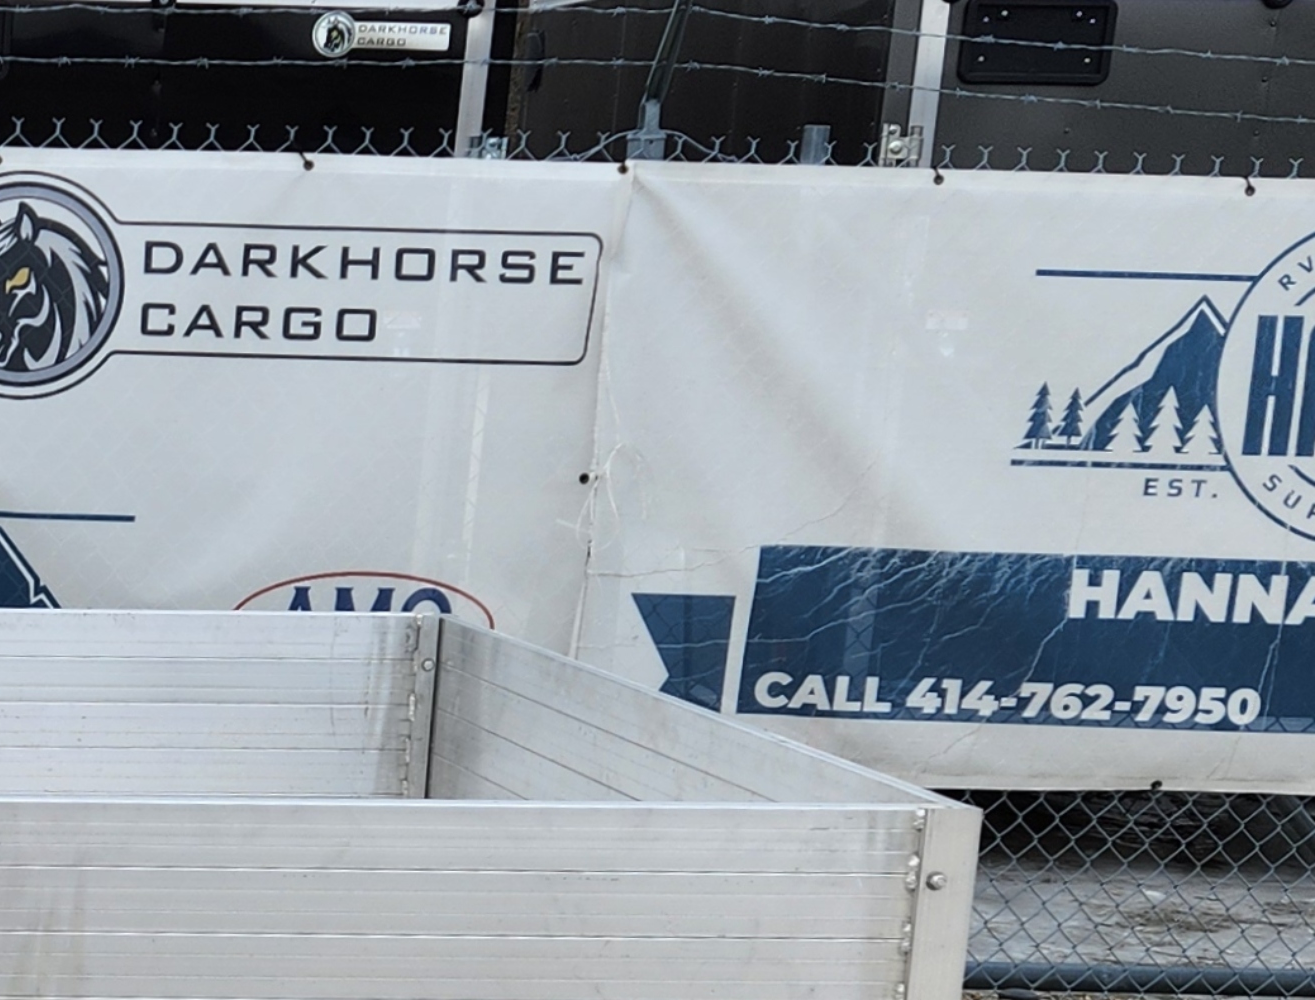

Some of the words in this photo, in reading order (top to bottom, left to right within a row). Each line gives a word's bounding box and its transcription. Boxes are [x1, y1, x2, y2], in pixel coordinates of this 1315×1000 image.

[357, 36, 407, 47] CARGO
[358, 23, 448, 36] DARKHORSE
[143, 240, 585, 286] DARKHORSE
[139, 302, 378, 342] CARGO
[1143, 477, 1219, 499] EST.
[754, 671, 892, 713] CALL
[905, 676, 1261, 726] 414-762-7950
